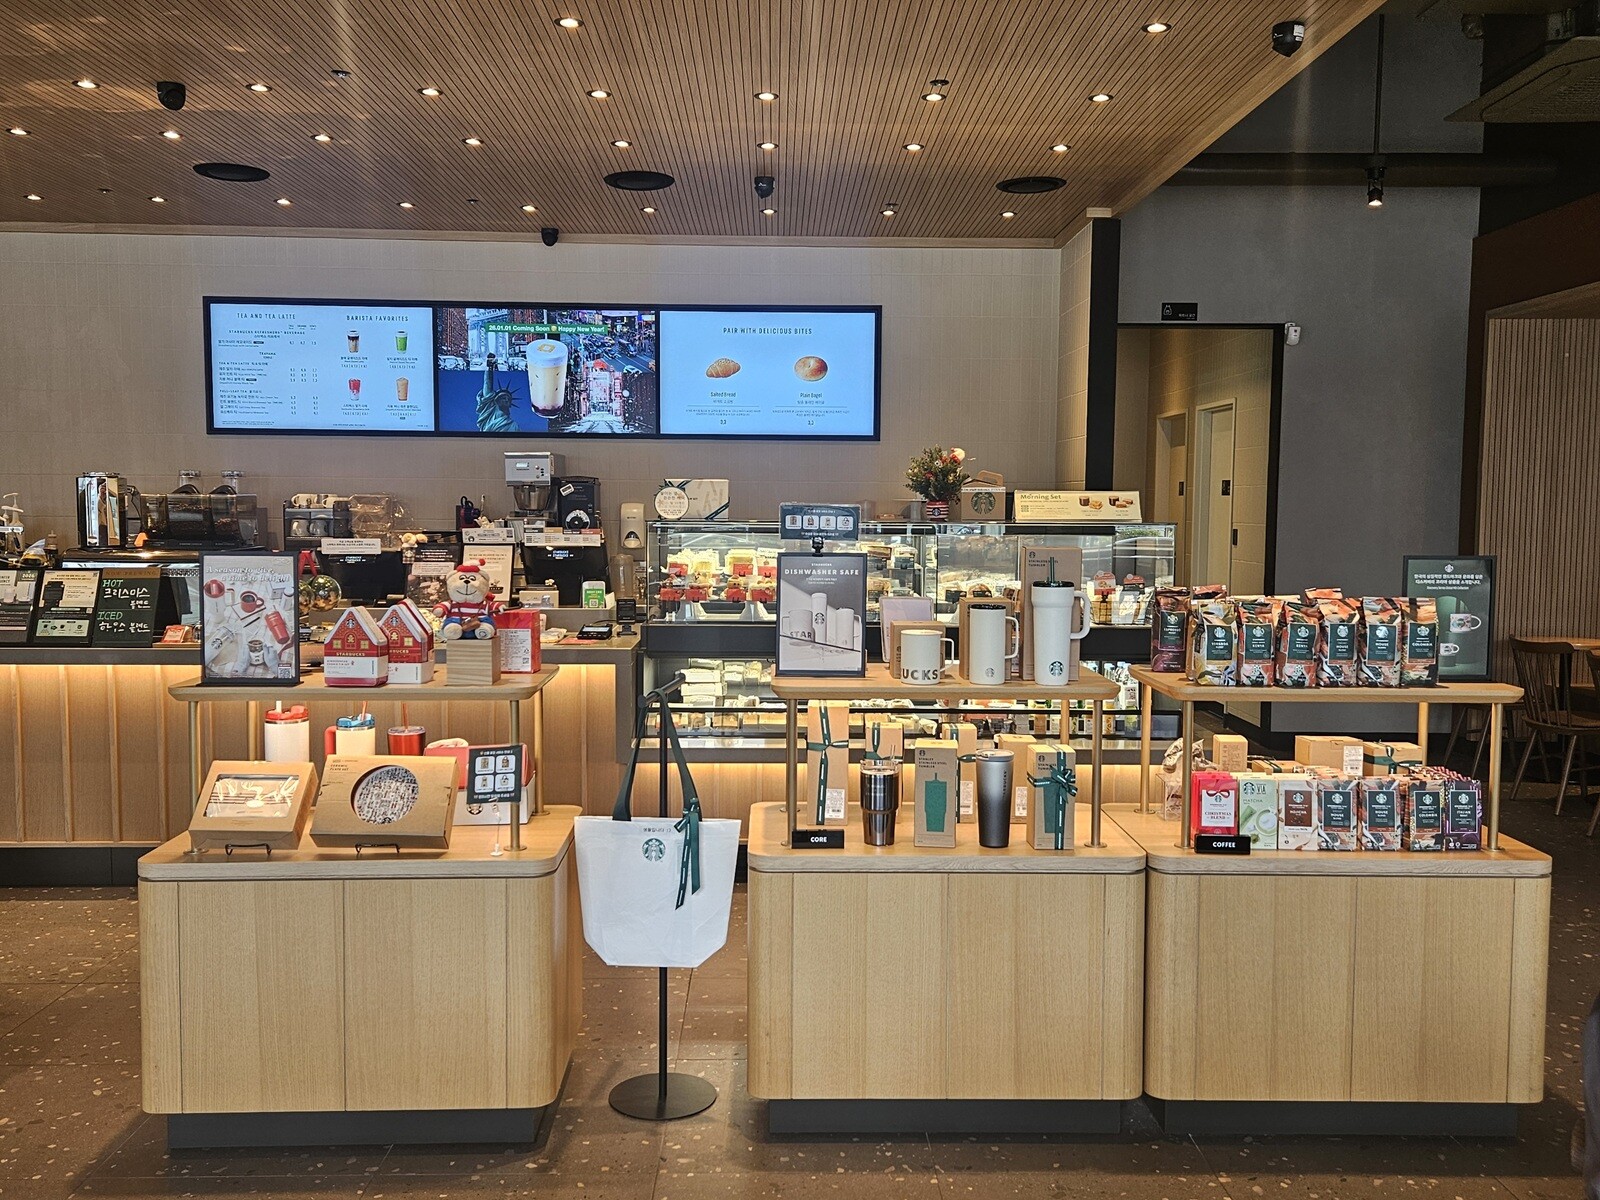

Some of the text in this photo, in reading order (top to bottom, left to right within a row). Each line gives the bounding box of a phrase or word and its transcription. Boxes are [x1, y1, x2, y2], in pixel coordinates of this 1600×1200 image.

[759, 327, 792, 335] DELICIOUS
[794, 327, 812, 335] BITES
[102, 579, 123, 587] HOT
[103, 587, 150, 598] 크리스마스
[130, 600, 150, 609] 블렌드
[96, 611, 123, 620] ICED
[99, 621, 150, 633] 하우스 블렌드
[789, 631, 812, 639] STAR
[1256, 784, 1266, 794] VIA
